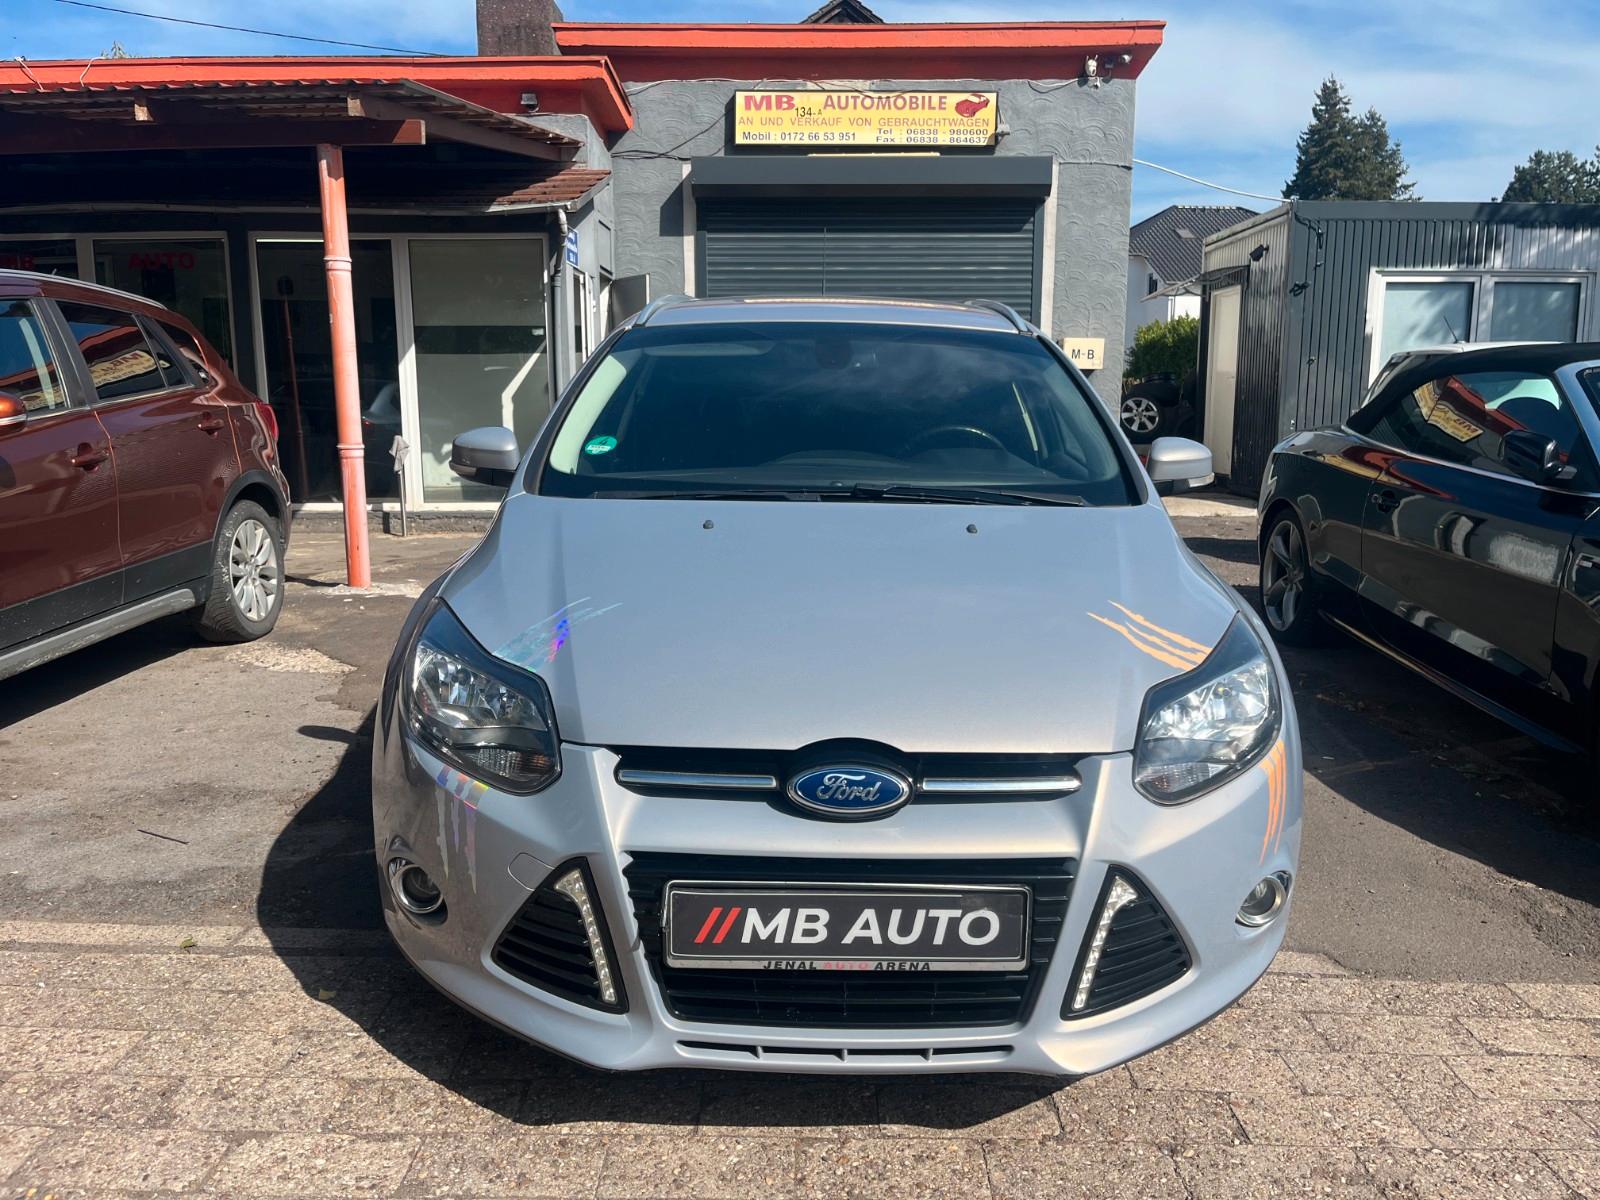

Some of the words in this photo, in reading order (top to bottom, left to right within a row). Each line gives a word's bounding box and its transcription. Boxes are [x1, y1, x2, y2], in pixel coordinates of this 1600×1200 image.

[744, 95, 795, 111] MB
[823, 94, 948, 110] AUTOMOBILE
[738, 117, 754, 127] AN
[760, 117, 784, 127] UND
[790, 117, 843, 127] VERKAUF
[848, 117, 872, 127] VON
[878, 117, 990, 127] GEBRAUCHTWAGEN
[742, 131, 771, 141] Mobil
[780, 131, 804, 141] 0172
[808, 131, 819, 141] 66
[823, 131, 835, 141] 53
[838, 131, 856, 141] 951
[128, 252, 196, 271] AUTO
[816, 773, 882, 801] Ford
[841, 908, 1000, 946] AUTO
[763, 961, 817, 970] JENAL
[822, 962, 869, 971] AUTO
[873, 962, 931, 971] ARENA
